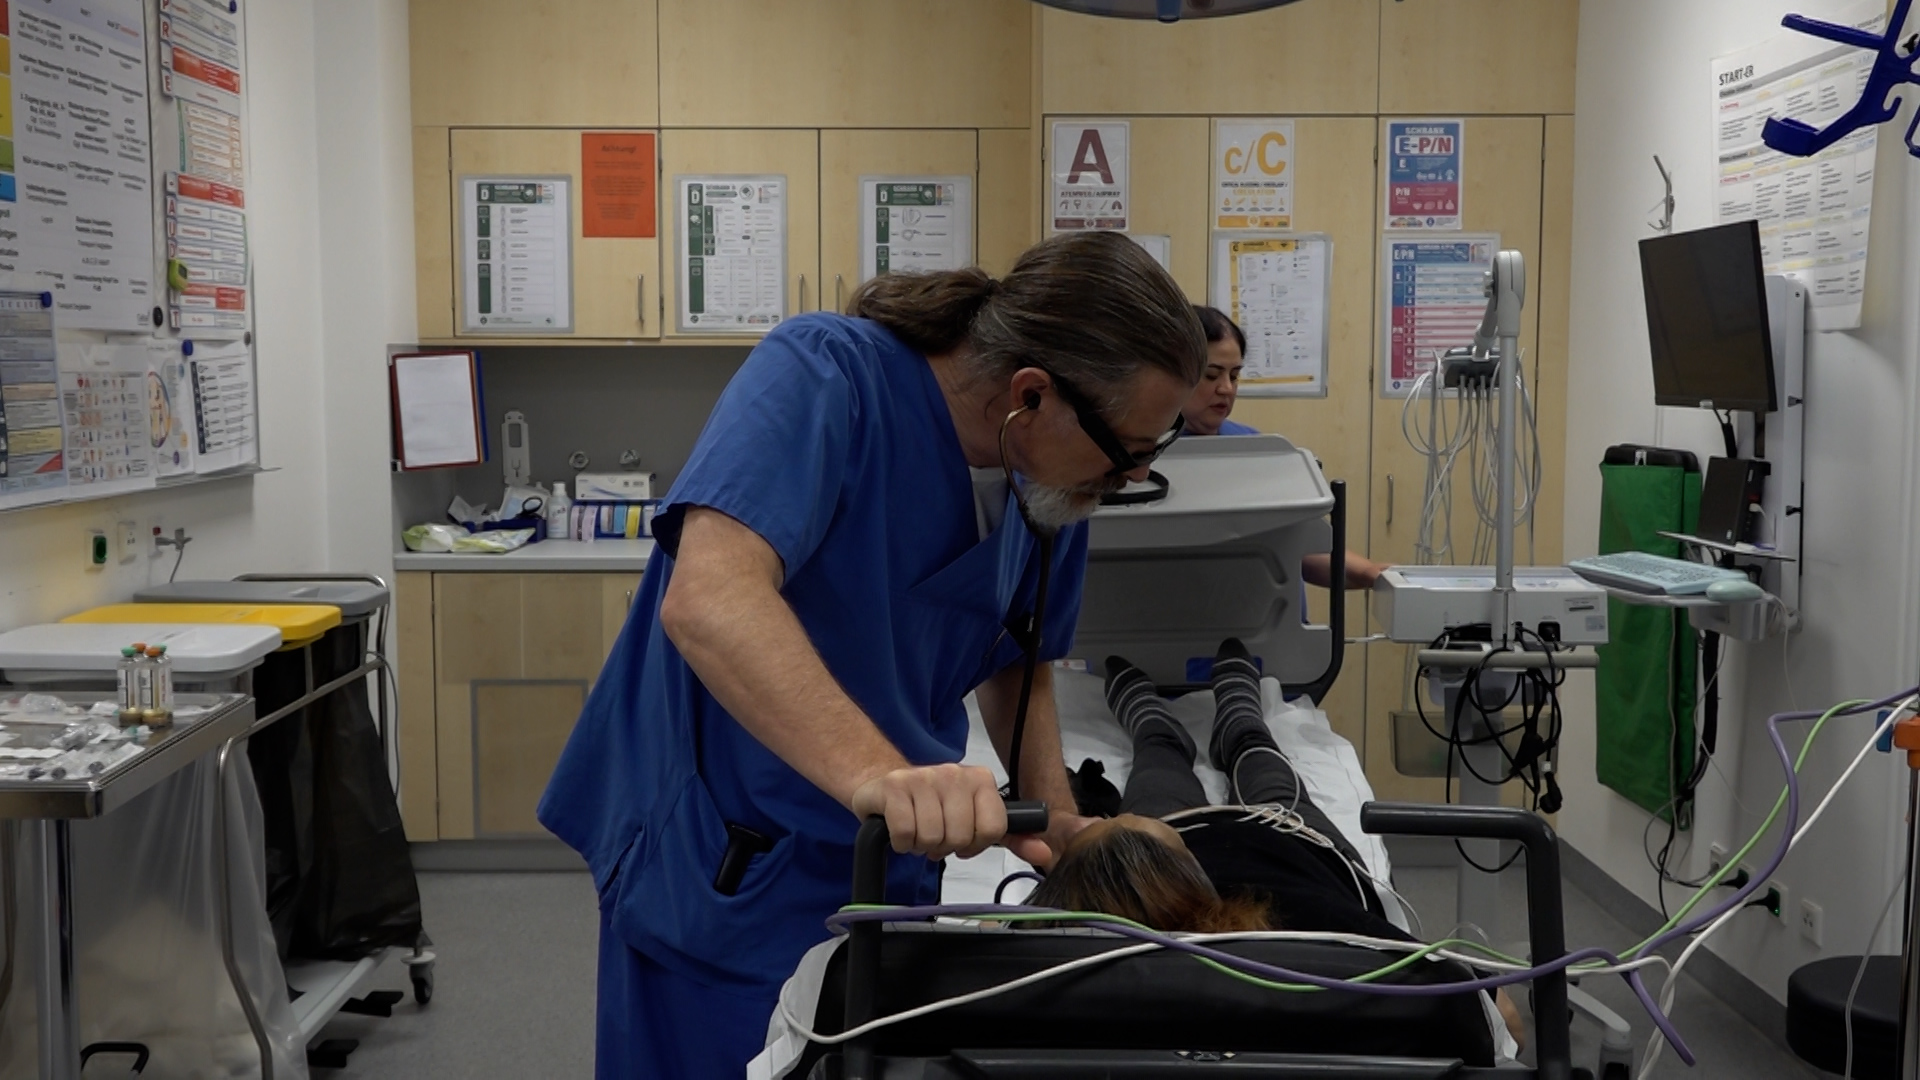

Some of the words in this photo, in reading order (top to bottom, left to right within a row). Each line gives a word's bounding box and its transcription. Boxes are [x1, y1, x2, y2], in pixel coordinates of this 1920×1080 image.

[1719, 65, 1754, 86] START-ER
[1405, 127, 1446, 135] SCHRANK
[1399, 136, 1453, 153] E-P/N
[1066, 129, 1115, 184] A
